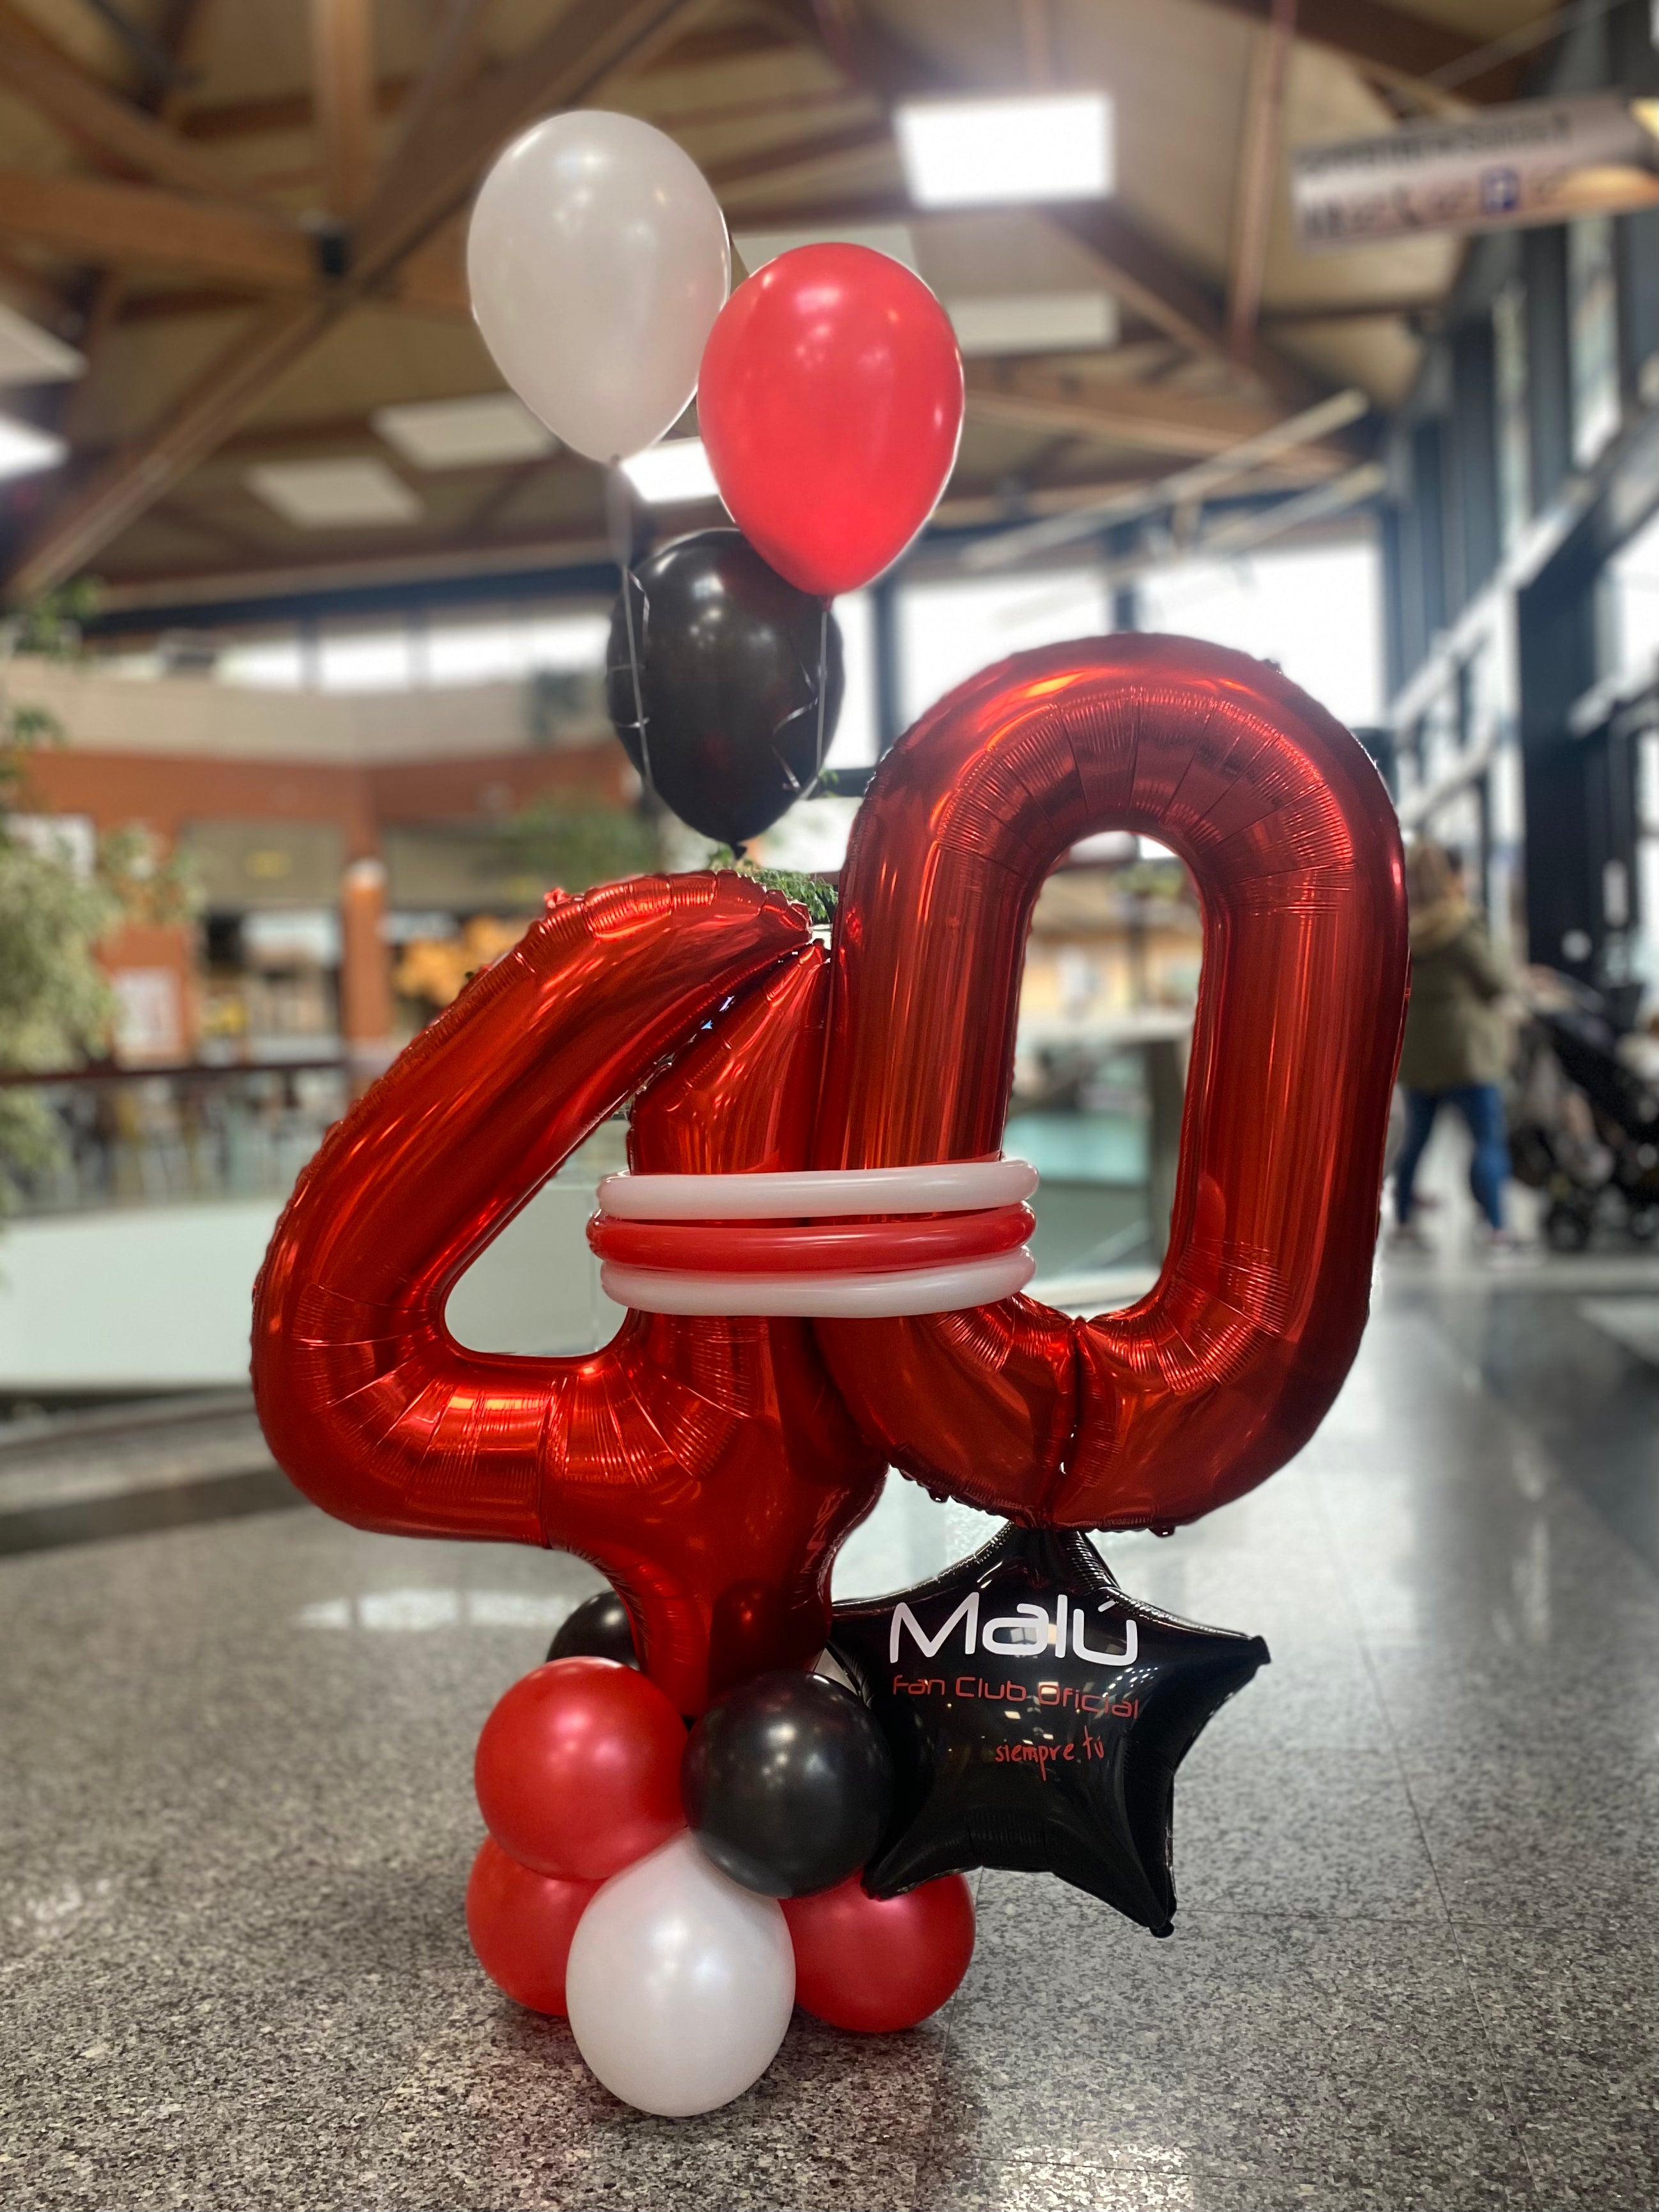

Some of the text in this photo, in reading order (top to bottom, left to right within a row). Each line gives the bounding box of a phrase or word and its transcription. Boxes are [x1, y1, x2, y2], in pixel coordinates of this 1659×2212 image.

[890, 1592, 1138, 1666] Malú
[956, 1676, 1027, 1702] Club
[1038, 1684, 1139, 1720] Oficial
[995, 1743, 1075, 1781] siempre
